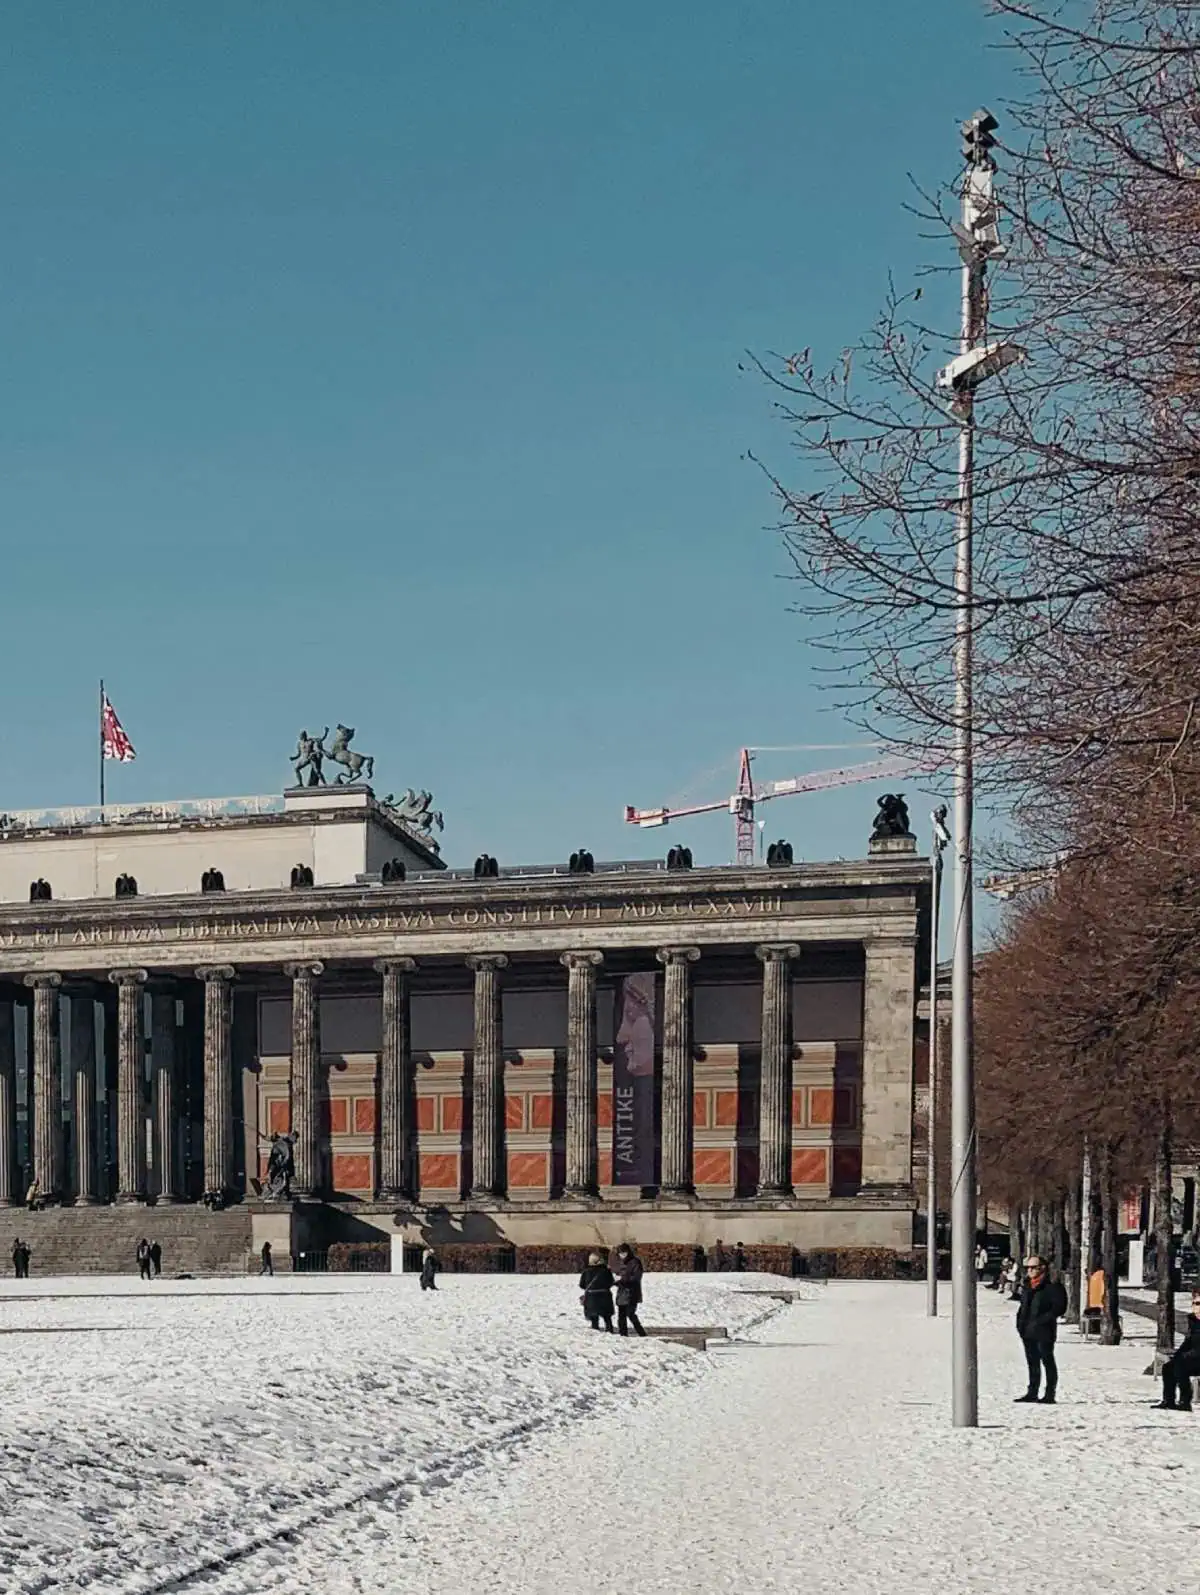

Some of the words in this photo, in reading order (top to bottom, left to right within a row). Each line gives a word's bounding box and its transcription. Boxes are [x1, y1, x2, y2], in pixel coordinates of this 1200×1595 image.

[33, 928, 62, 945] ET
[72, 923, 165, 943] ARTIVM
[175, 915, 320, 937] LIBERALIVM
[332, 910, 436, 932] MVSEVM
[448, 902, 602, 925] CONSTITVIT
[618, 896, 782, 919] MDCCCXXVIII
[617, 1087, 634, 1164] ANTIKE
